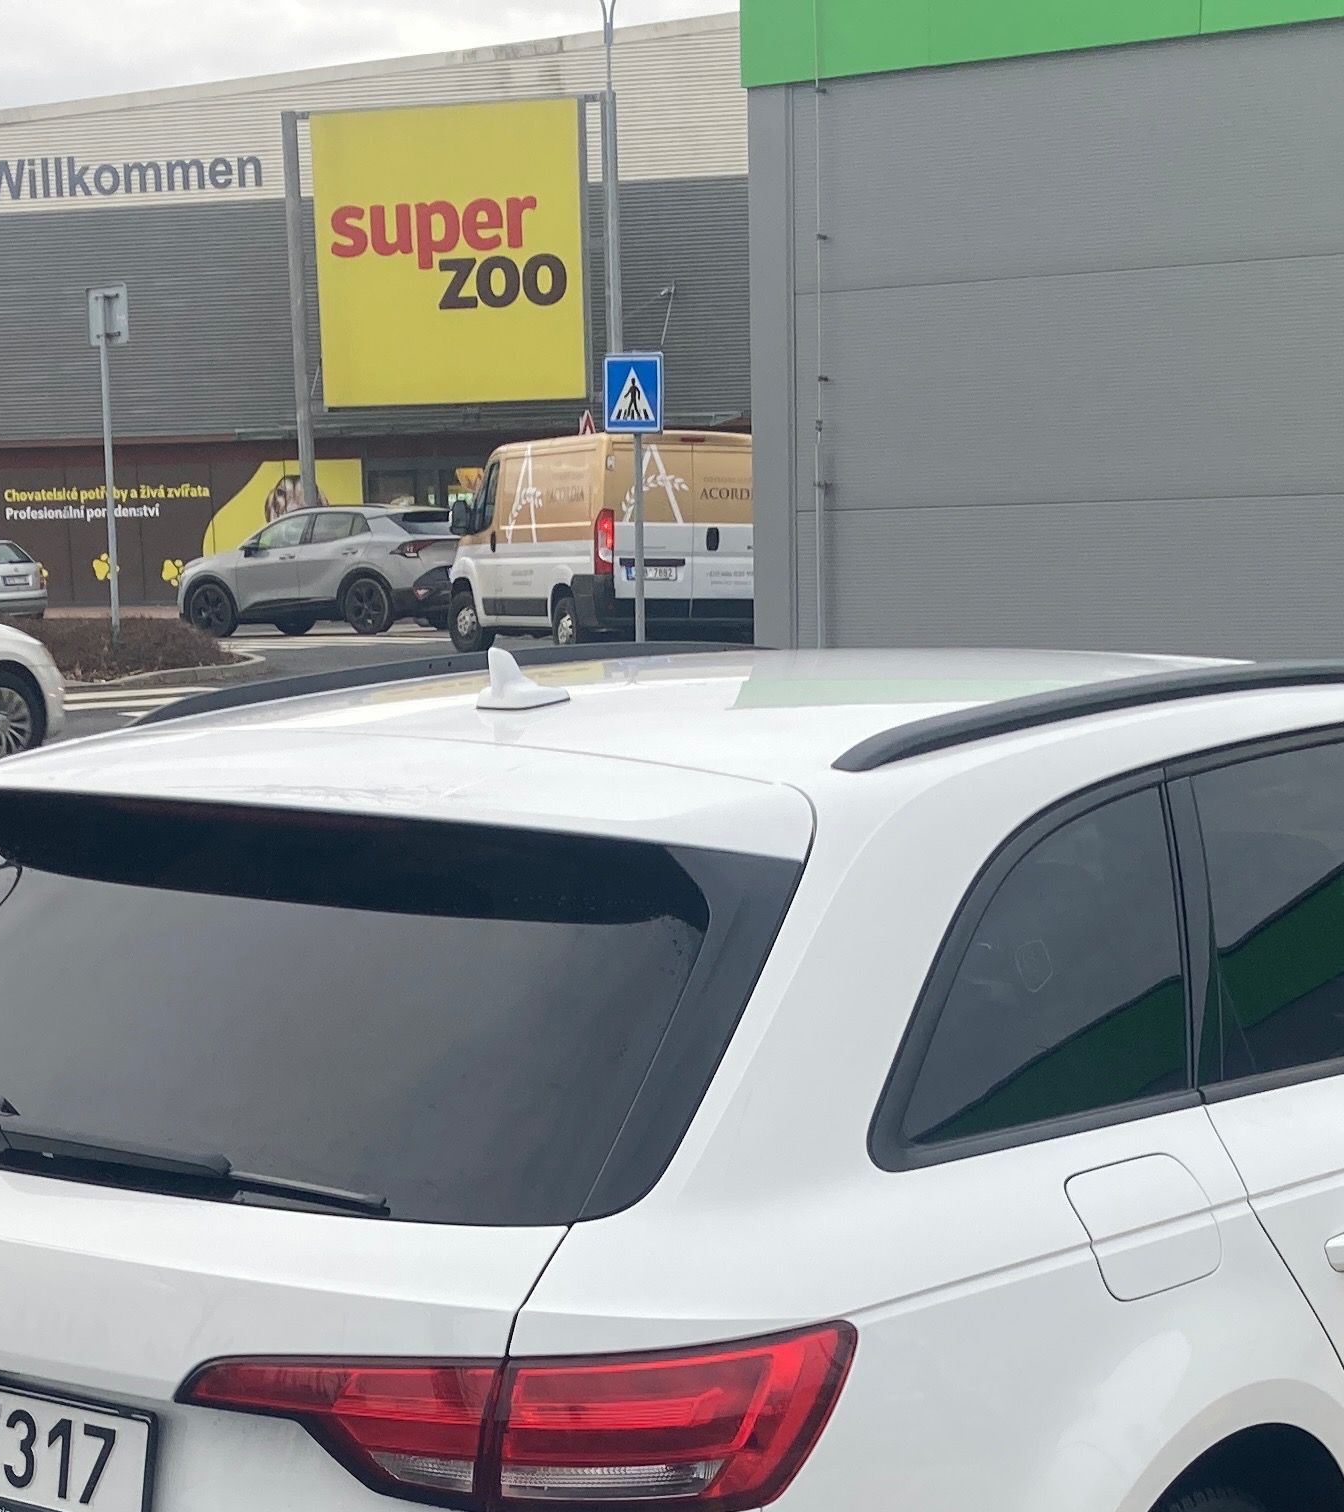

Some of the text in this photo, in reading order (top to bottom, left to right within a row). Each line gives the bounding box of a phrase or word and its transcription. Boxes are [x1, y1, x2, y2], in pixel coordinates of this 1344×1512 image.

[331, 195, 537, 270] super
[438, 253, 568, 310] zoo
[4, 483, 210, 504] Chovatelské potřby a živá zvířata
[5, 502, 160, 522] Profesionální pordenství
